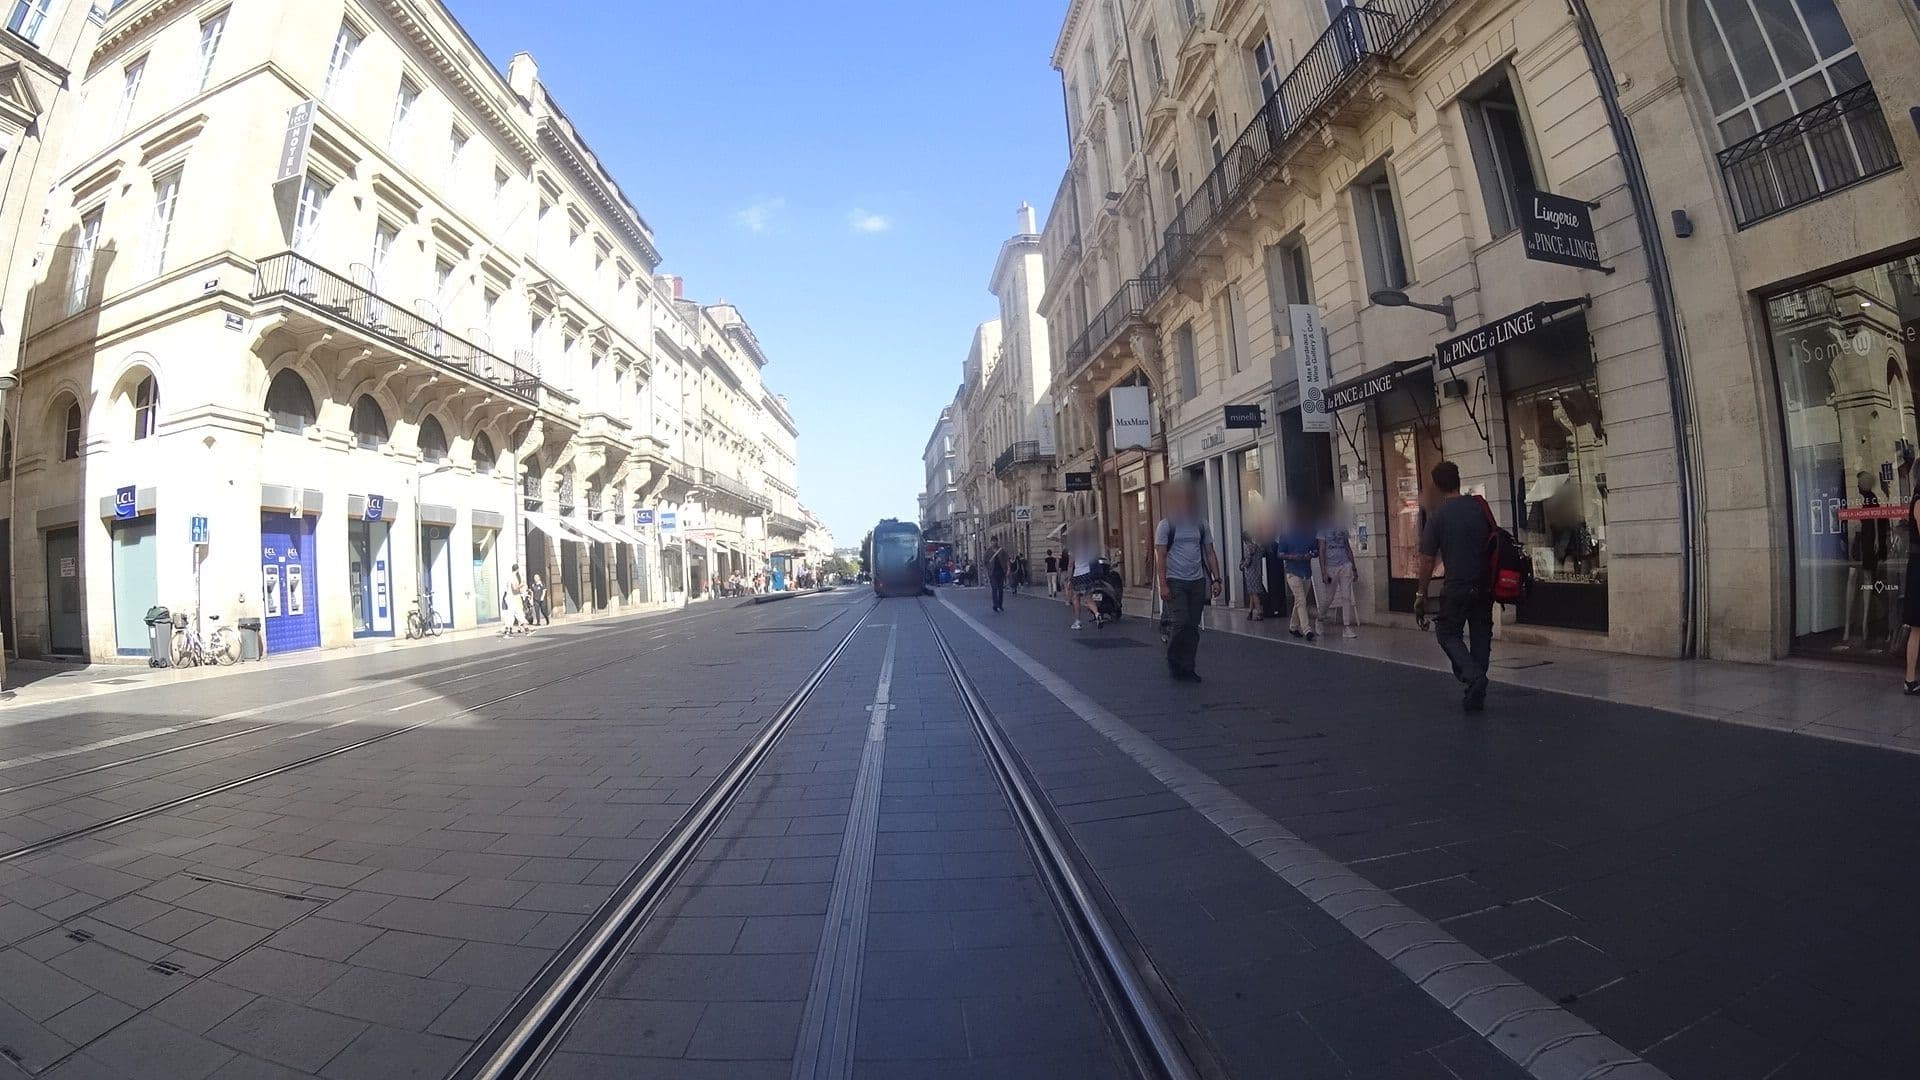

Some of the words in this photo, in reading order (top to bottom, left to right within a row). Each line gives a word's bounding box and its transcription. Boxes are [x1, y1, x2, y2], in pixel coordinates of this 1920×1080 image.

[286, 128, 300, 176] HOTEL
[1534, 197, 1580, 230] Lingerie
[1535, 232, 1565, 254] PINCE
[1568, 238, 1598, 261] LINGE
[1302, 334, 1311, 366] Bordeaux
[1309, 340, 1318, 364] Gallery
[1443, 350, 1451, 363] la
[1452, 332, 1487, 360] PINCE
[1489, 332, 1495, 347] à
[1496, 312, 1535, 343] LINGE
[1327, 398, 1333, 409] la
[1334, 386, 1358, 407] PINCE
[1364, 375, 1392, 397] LINGE
[1230, 412, 1257, 422] minelli
[117, 492, 134, 504] LCL
[368, 499, 381, 508] LCL
